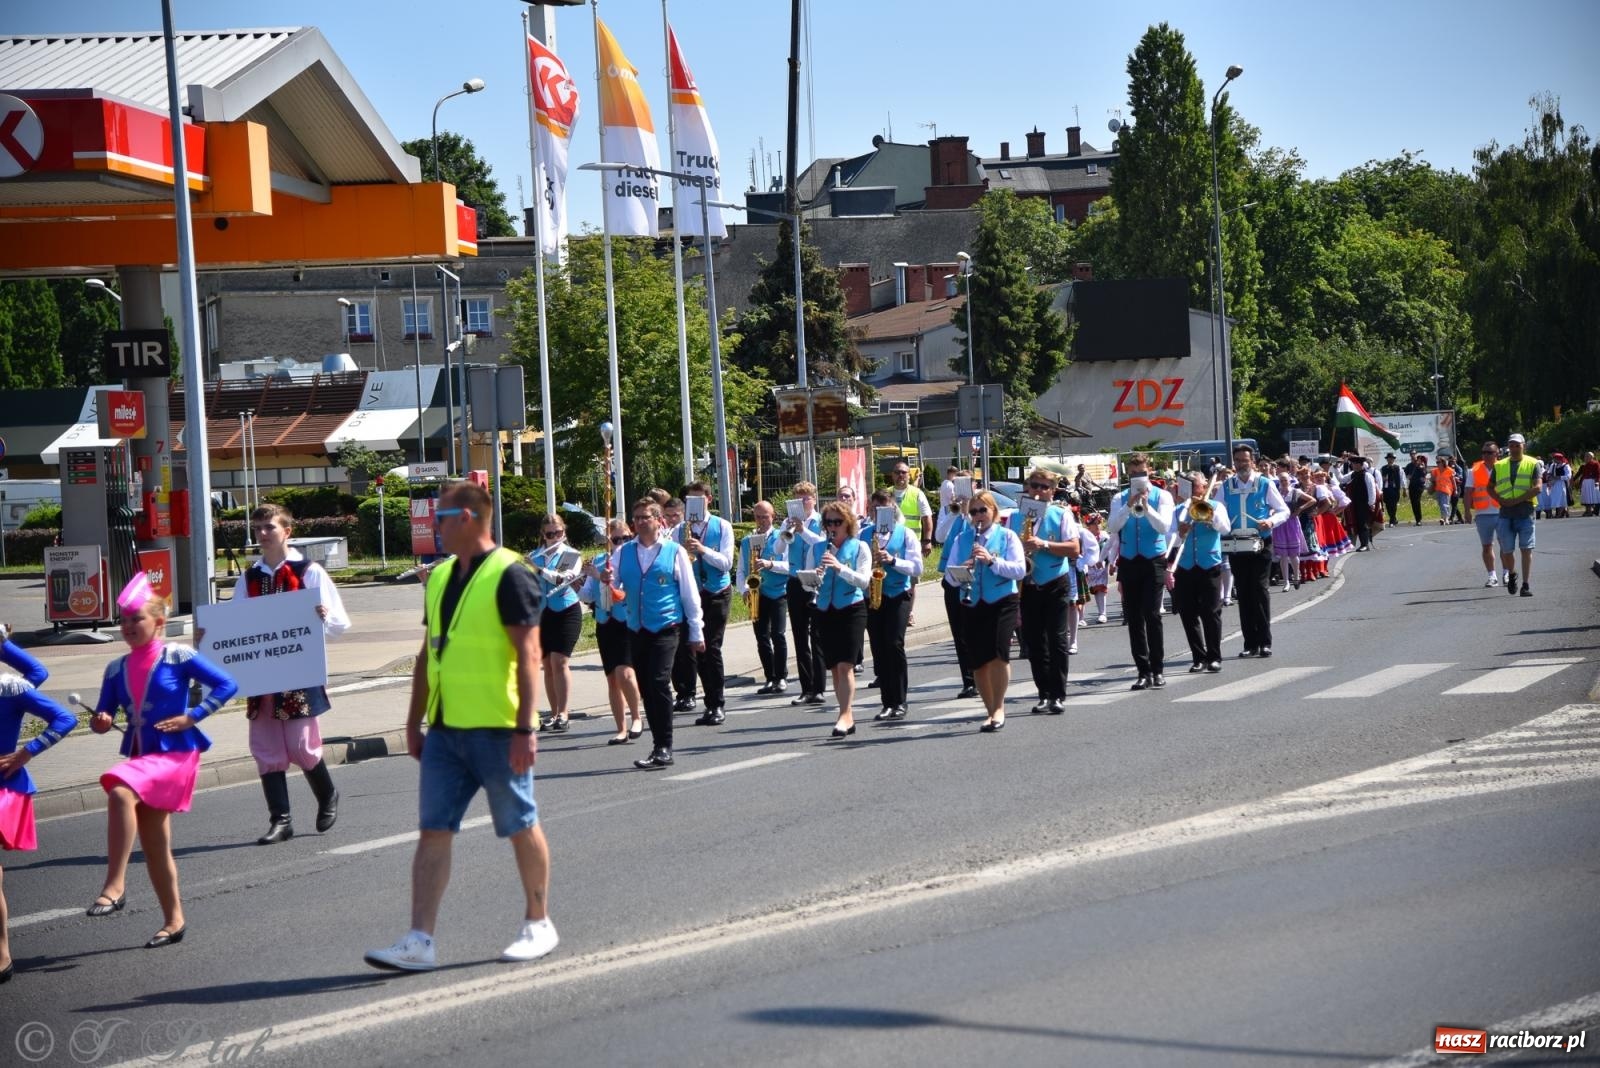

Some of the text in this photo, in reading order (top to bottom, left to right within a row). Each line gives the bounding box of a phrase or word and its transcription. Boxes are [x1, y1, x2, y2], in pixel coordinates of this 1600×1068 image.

[615, 181, 658, 201] diesel
[111, 341, 165, 367] TIR
[1112, 378, 1184, 412] ZDZ
[156, 441, 165, 454] 7
[420, 466, 440, 474] GASPOL
[212, 626, 312, 651] ORKIESTRA DĘTA
[223, 643, 303, 664] GMINY NĘDZA
